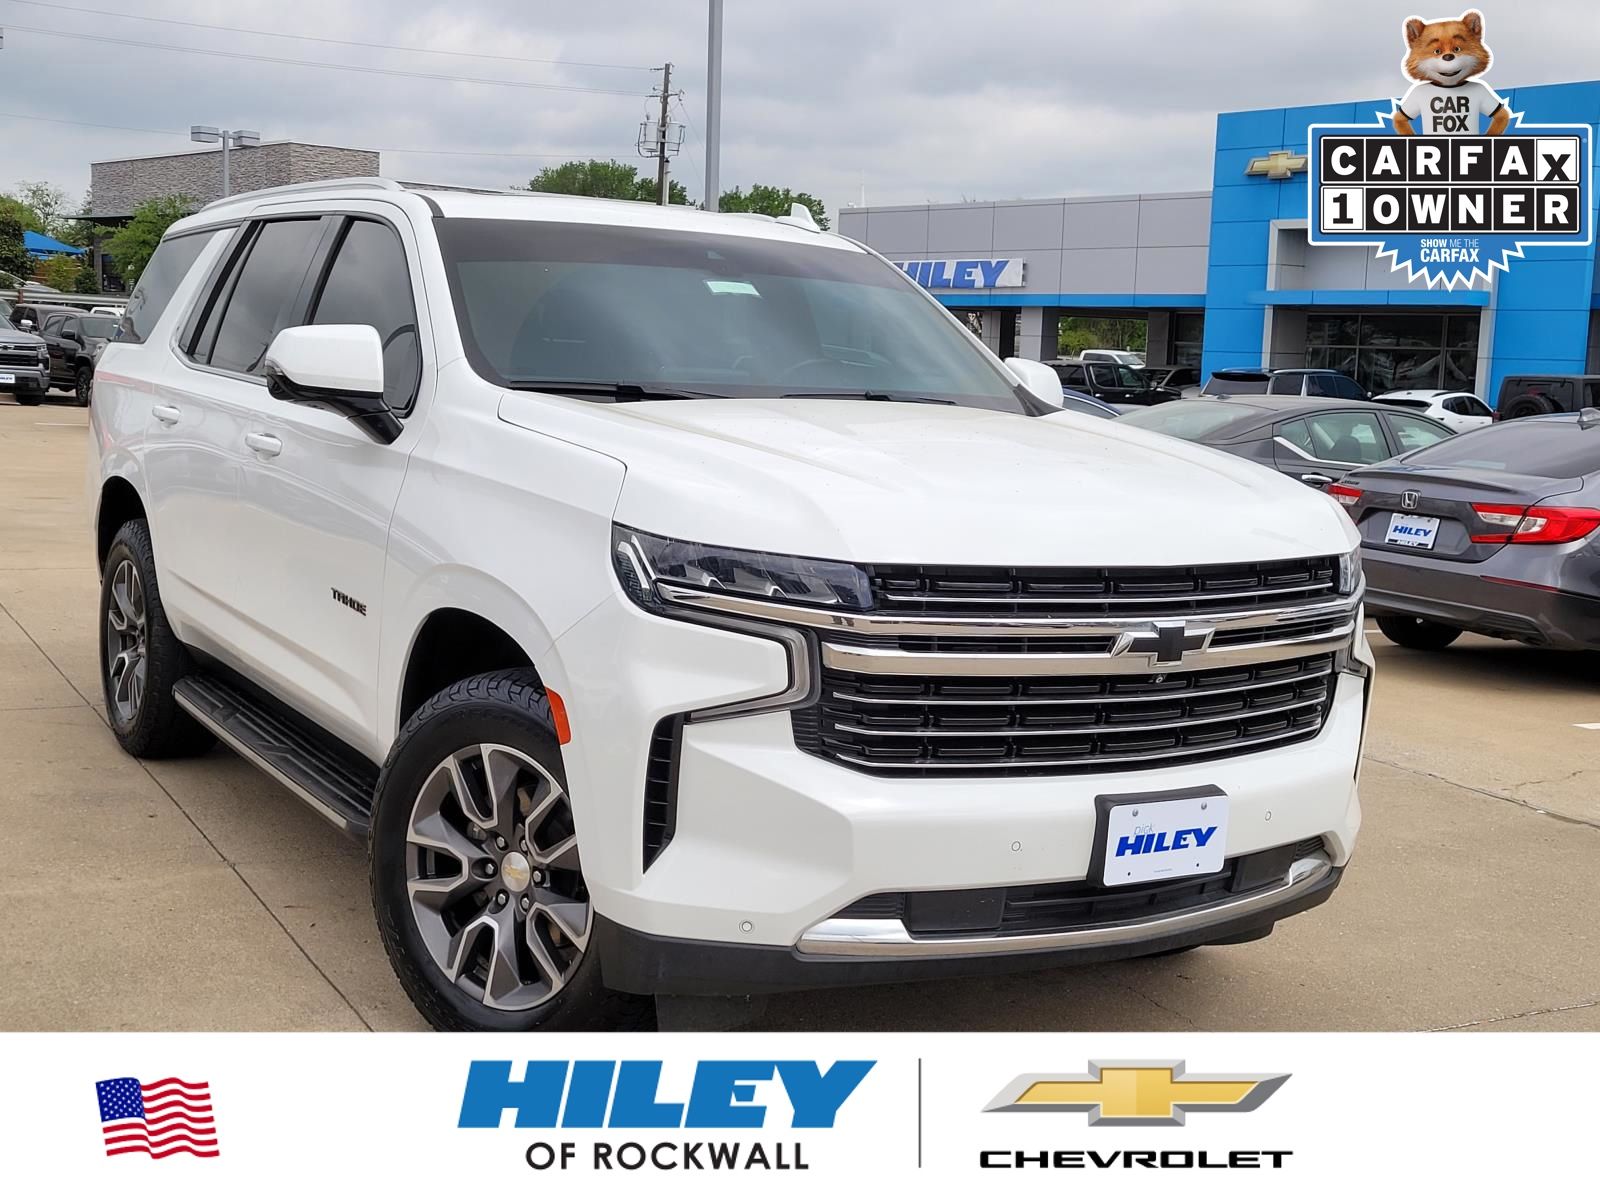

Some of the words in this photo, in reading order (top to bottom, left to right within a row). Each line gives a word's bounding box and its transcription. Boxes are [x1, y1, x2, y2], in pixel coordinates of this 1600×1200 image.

[1392, 525, 1433, 537] HILEY
[330, 586, 367, 617] TAHOE
[1115, 825, 1218, 857] HILEY
